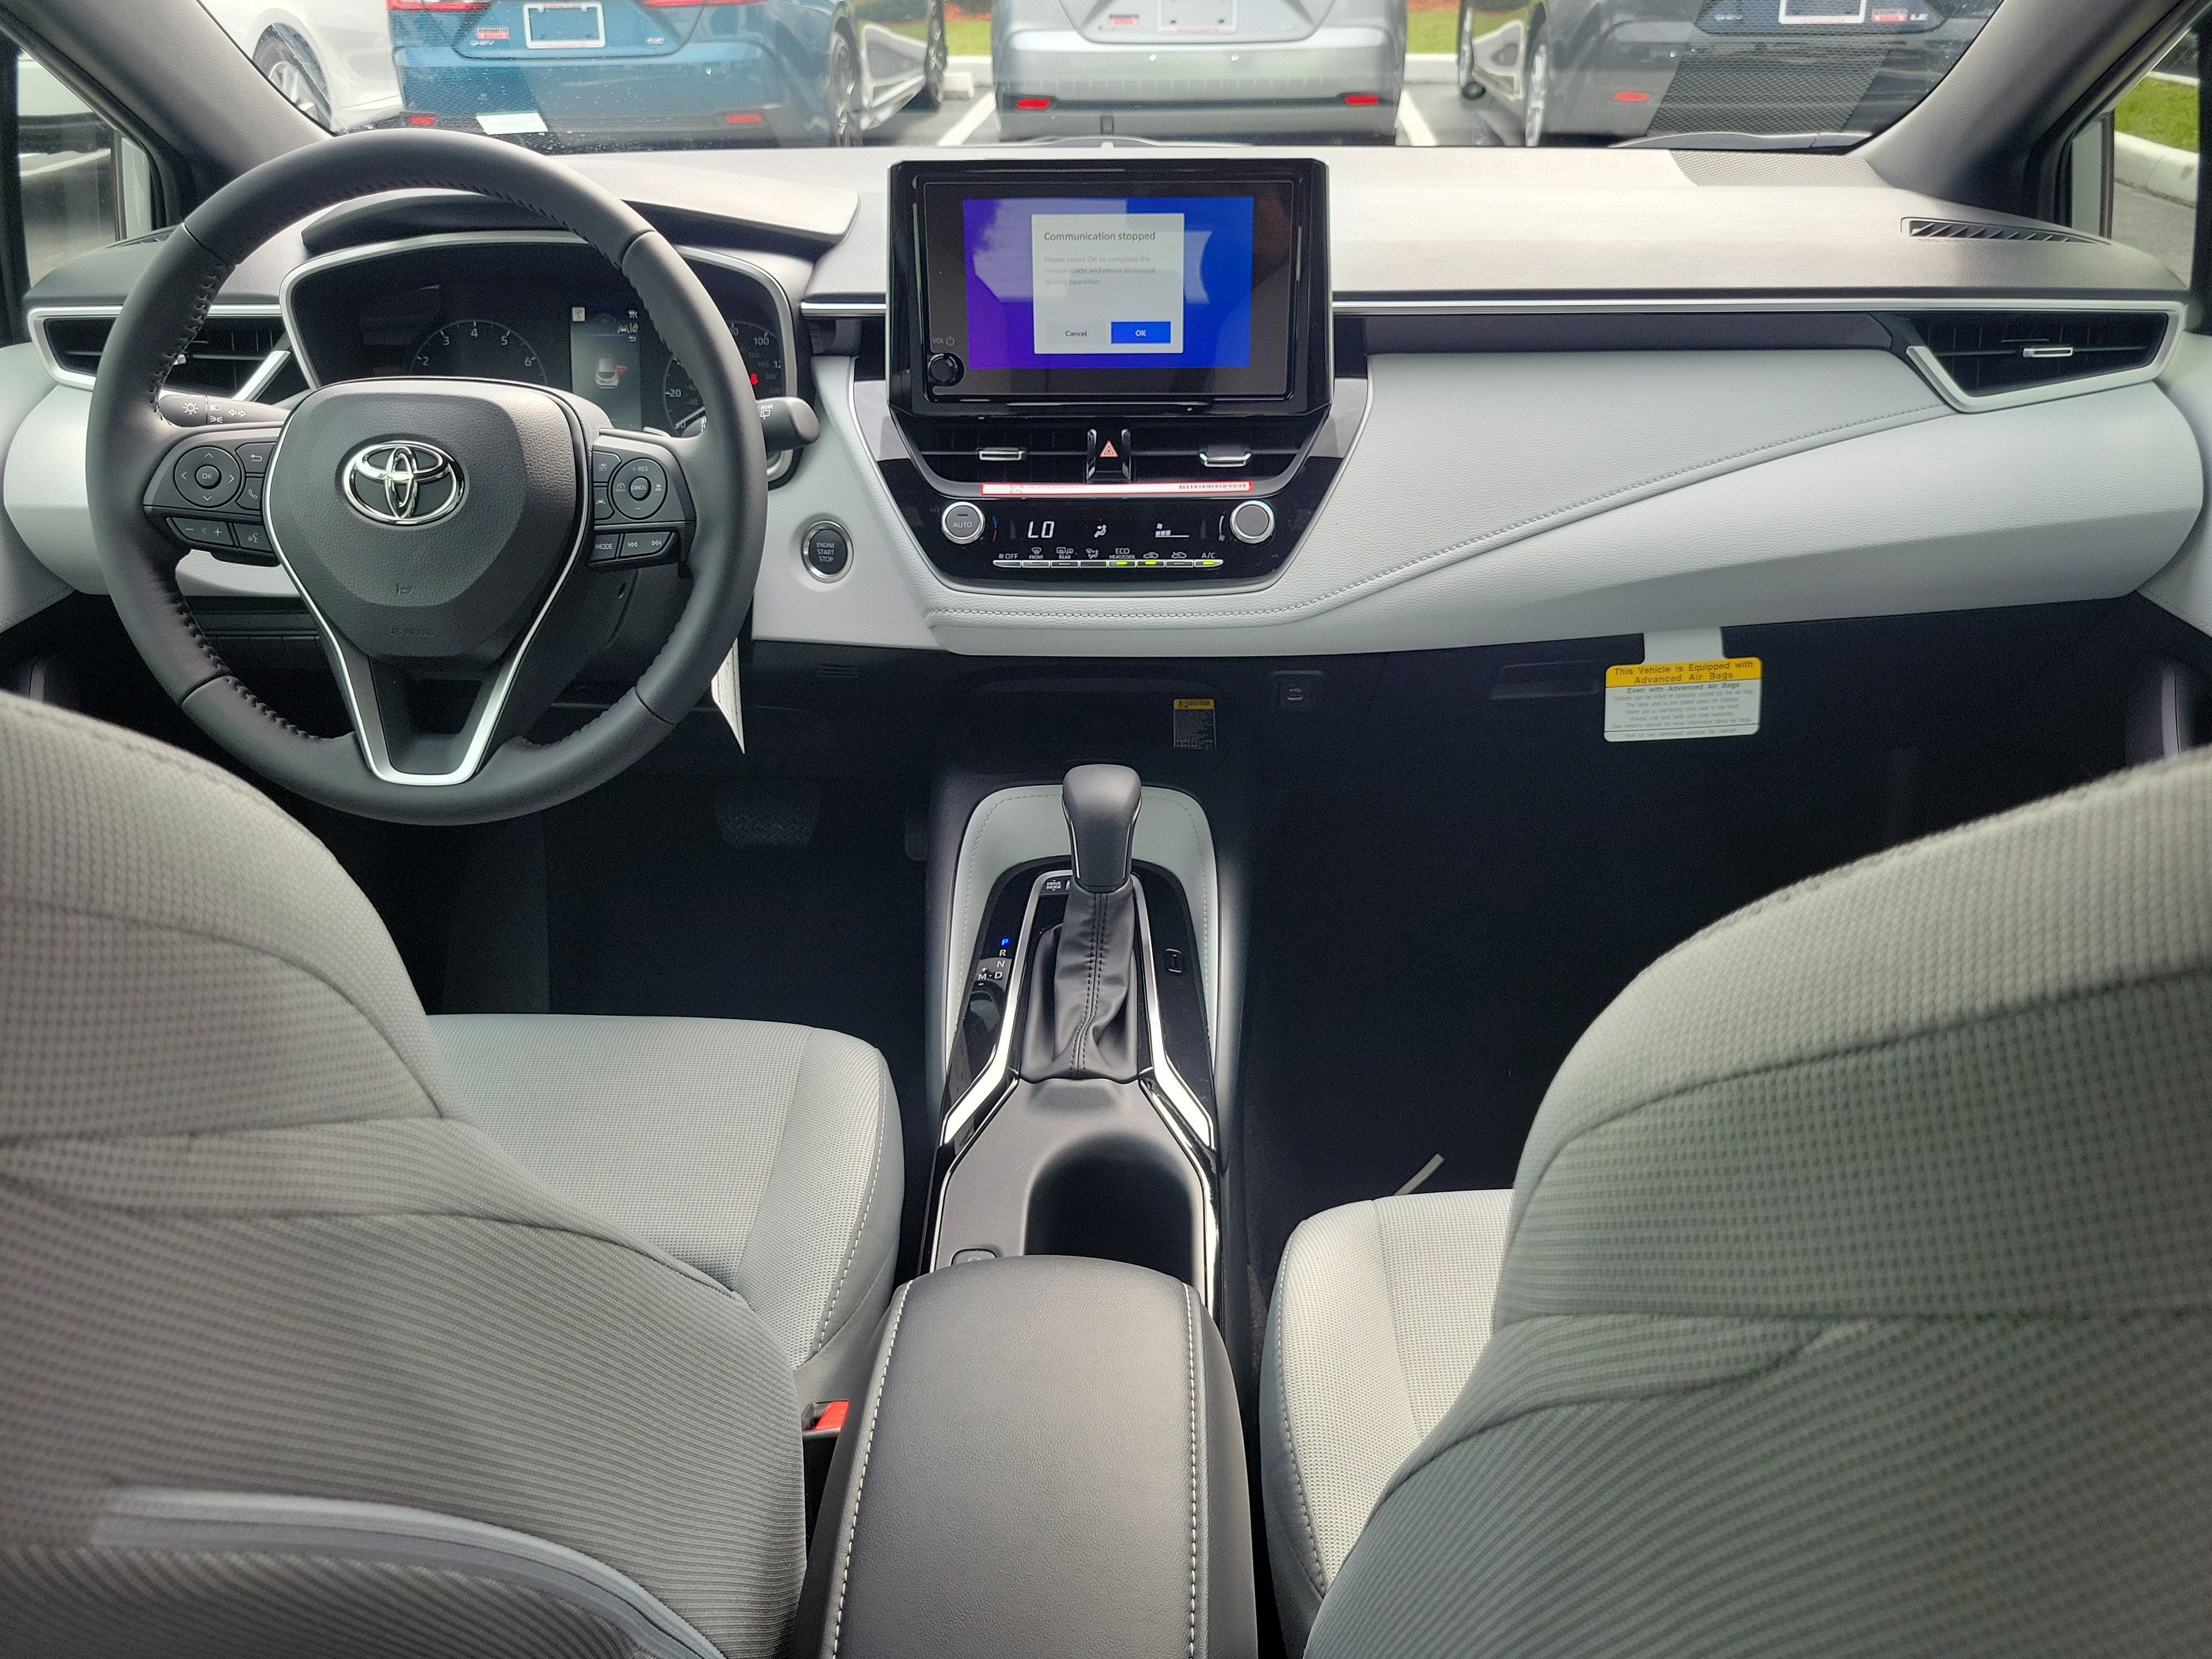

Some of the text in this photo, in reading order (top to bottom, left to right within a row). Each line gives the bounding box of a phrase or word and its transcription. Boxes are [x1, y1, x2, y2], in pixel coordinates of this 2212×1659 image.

[1044, 232, 1155, 242] Communication stopped
[470, 329, 478, 337] 4
[443, 336, 450, 345] 3
[501, 336, 507, 345] 5
[422, 357, 429, 366] 2
[525, 358, 532, 366] 6
[670, 389, 681, 397] 20
[1638, 666, 1671, 675] Vehicle
[1689, 662, 1730, 672] Equipped
[1634, 675, 1681, 684] Advanced
[1709, 672, 1733, 680] Bags
[1667, 684, 1703, 692] Advanced
[994, 971, 1003, 979] D
